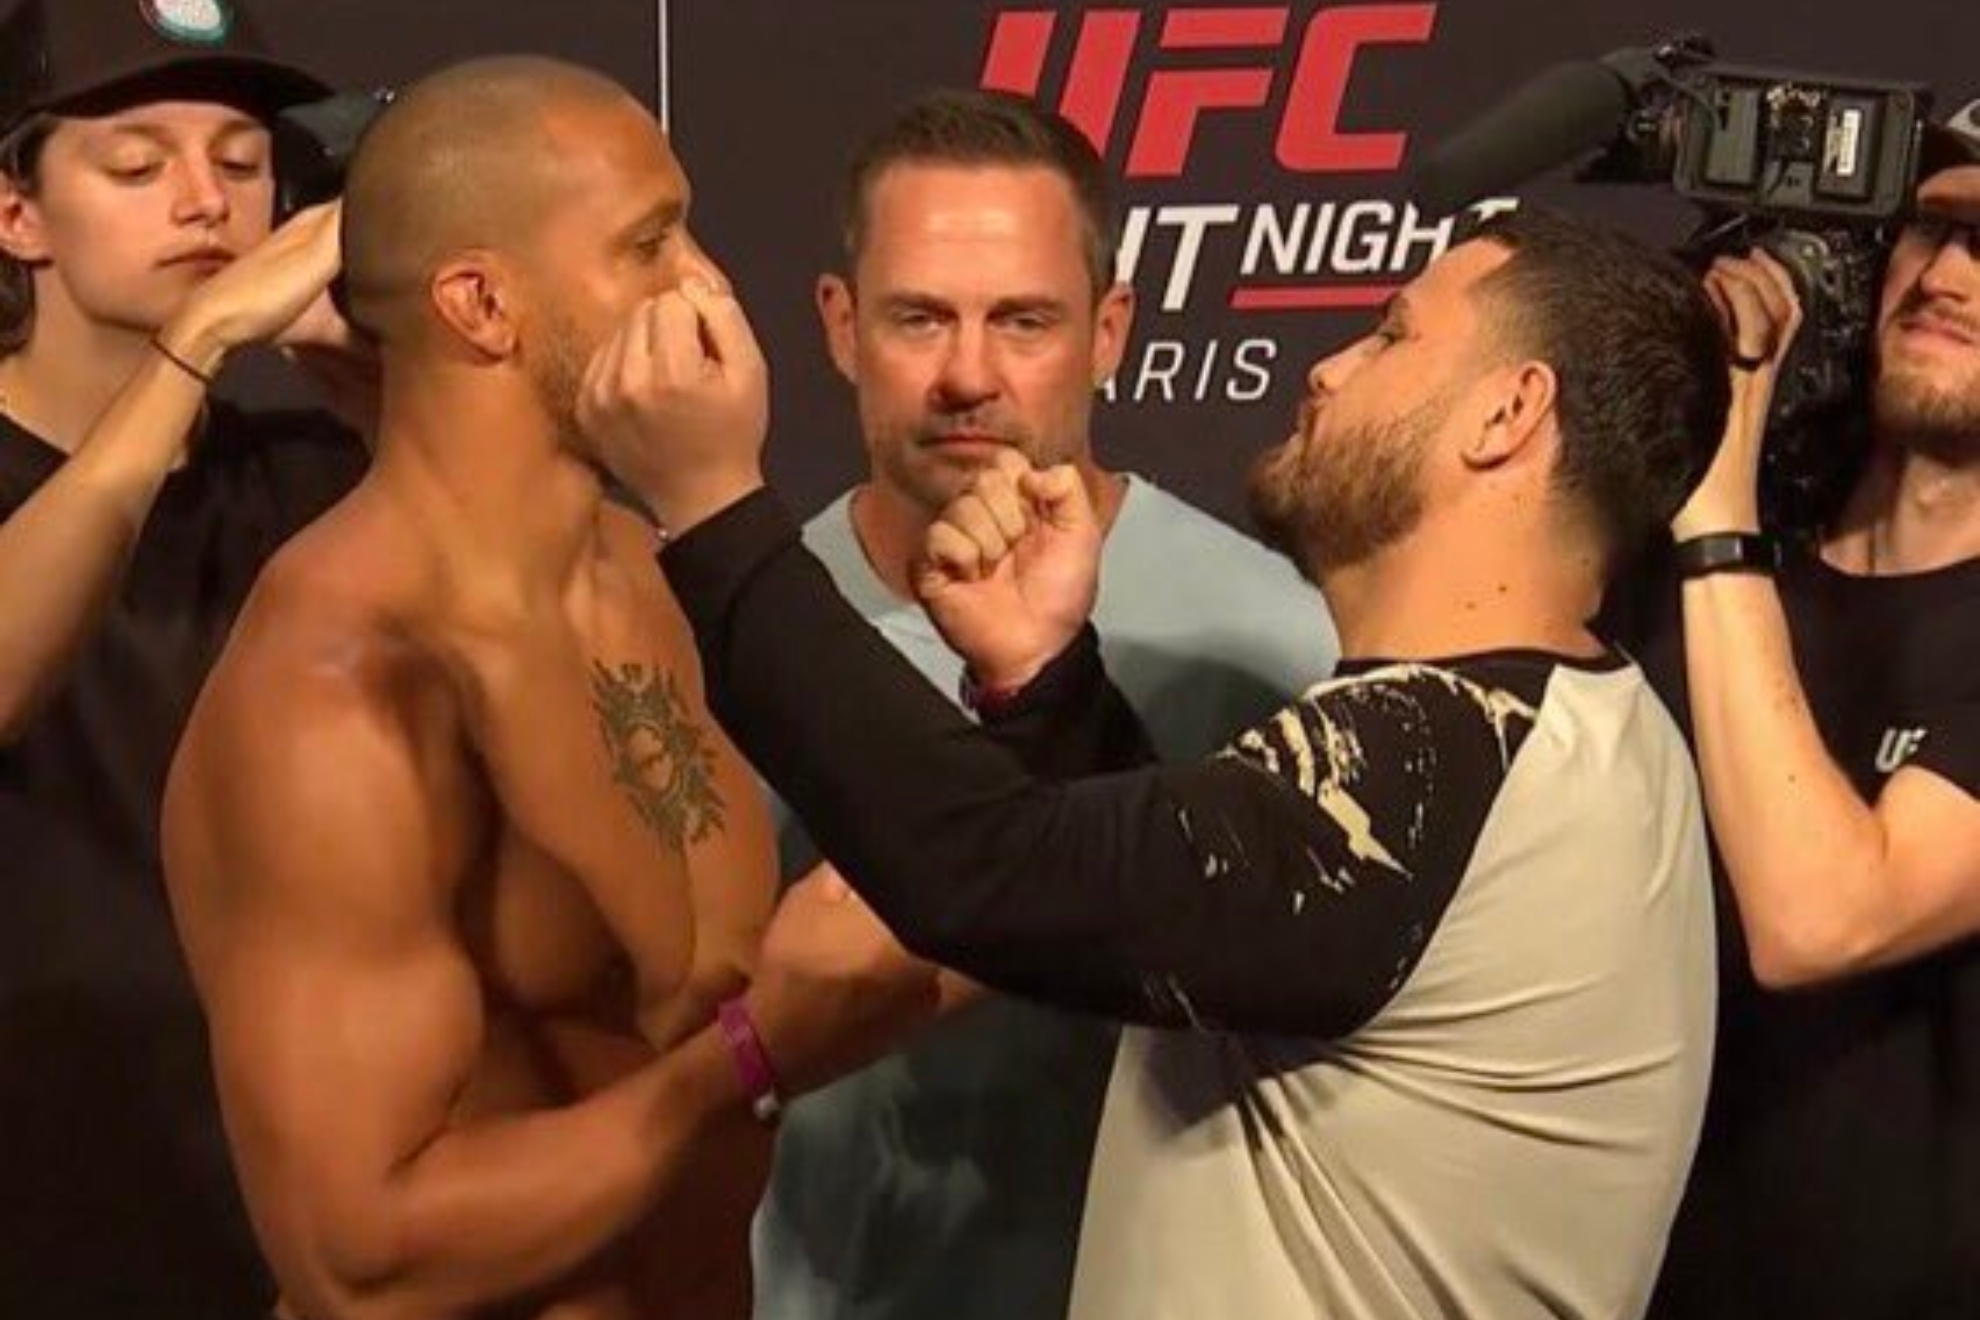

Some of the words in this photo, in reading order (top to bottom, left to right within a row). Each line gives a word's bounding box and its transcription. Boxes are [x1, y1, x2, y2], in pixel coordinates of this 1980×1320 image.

[980, 3, 1436, 177] UFC
[1104, 339, 1278, 402] RIS
[1875, 728, 1927, 772] UF
